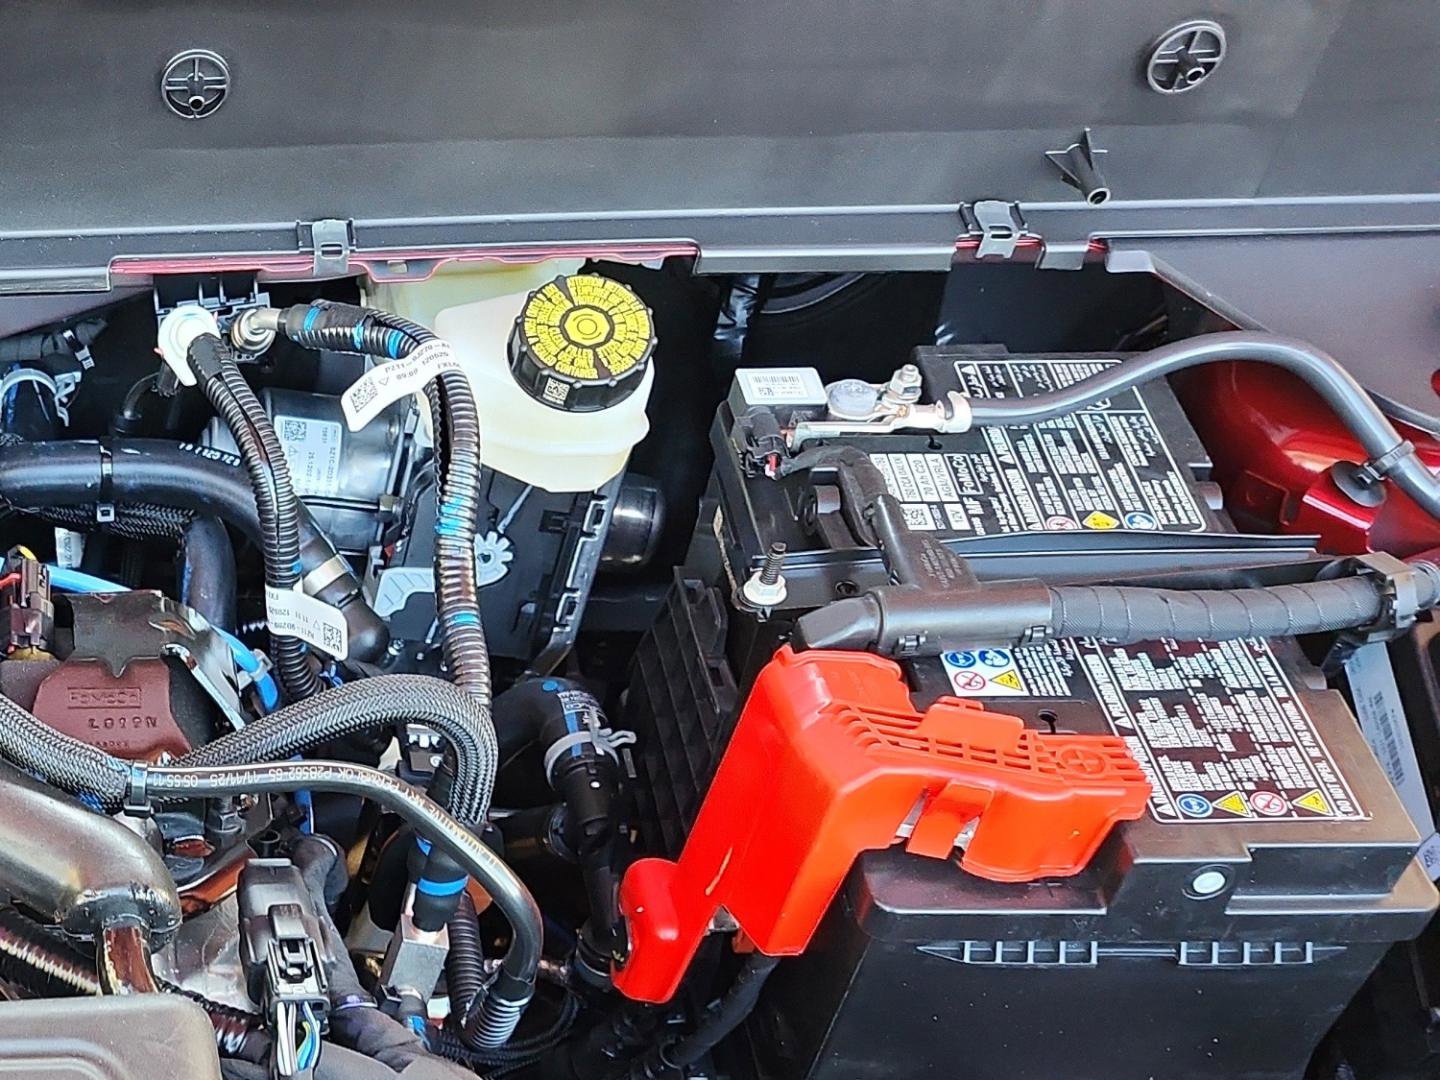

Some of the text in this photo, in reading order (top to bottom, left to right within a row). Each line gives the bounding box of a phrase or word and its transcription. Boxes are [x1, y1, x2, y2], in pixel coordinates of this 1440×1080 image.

[944, 455, 981, 492] FoMoCo
[960, 497, 985, 514] MF
[1310, 760, 1338, 782] OPEN.
[1323, 783, 1347, 798] NOT
